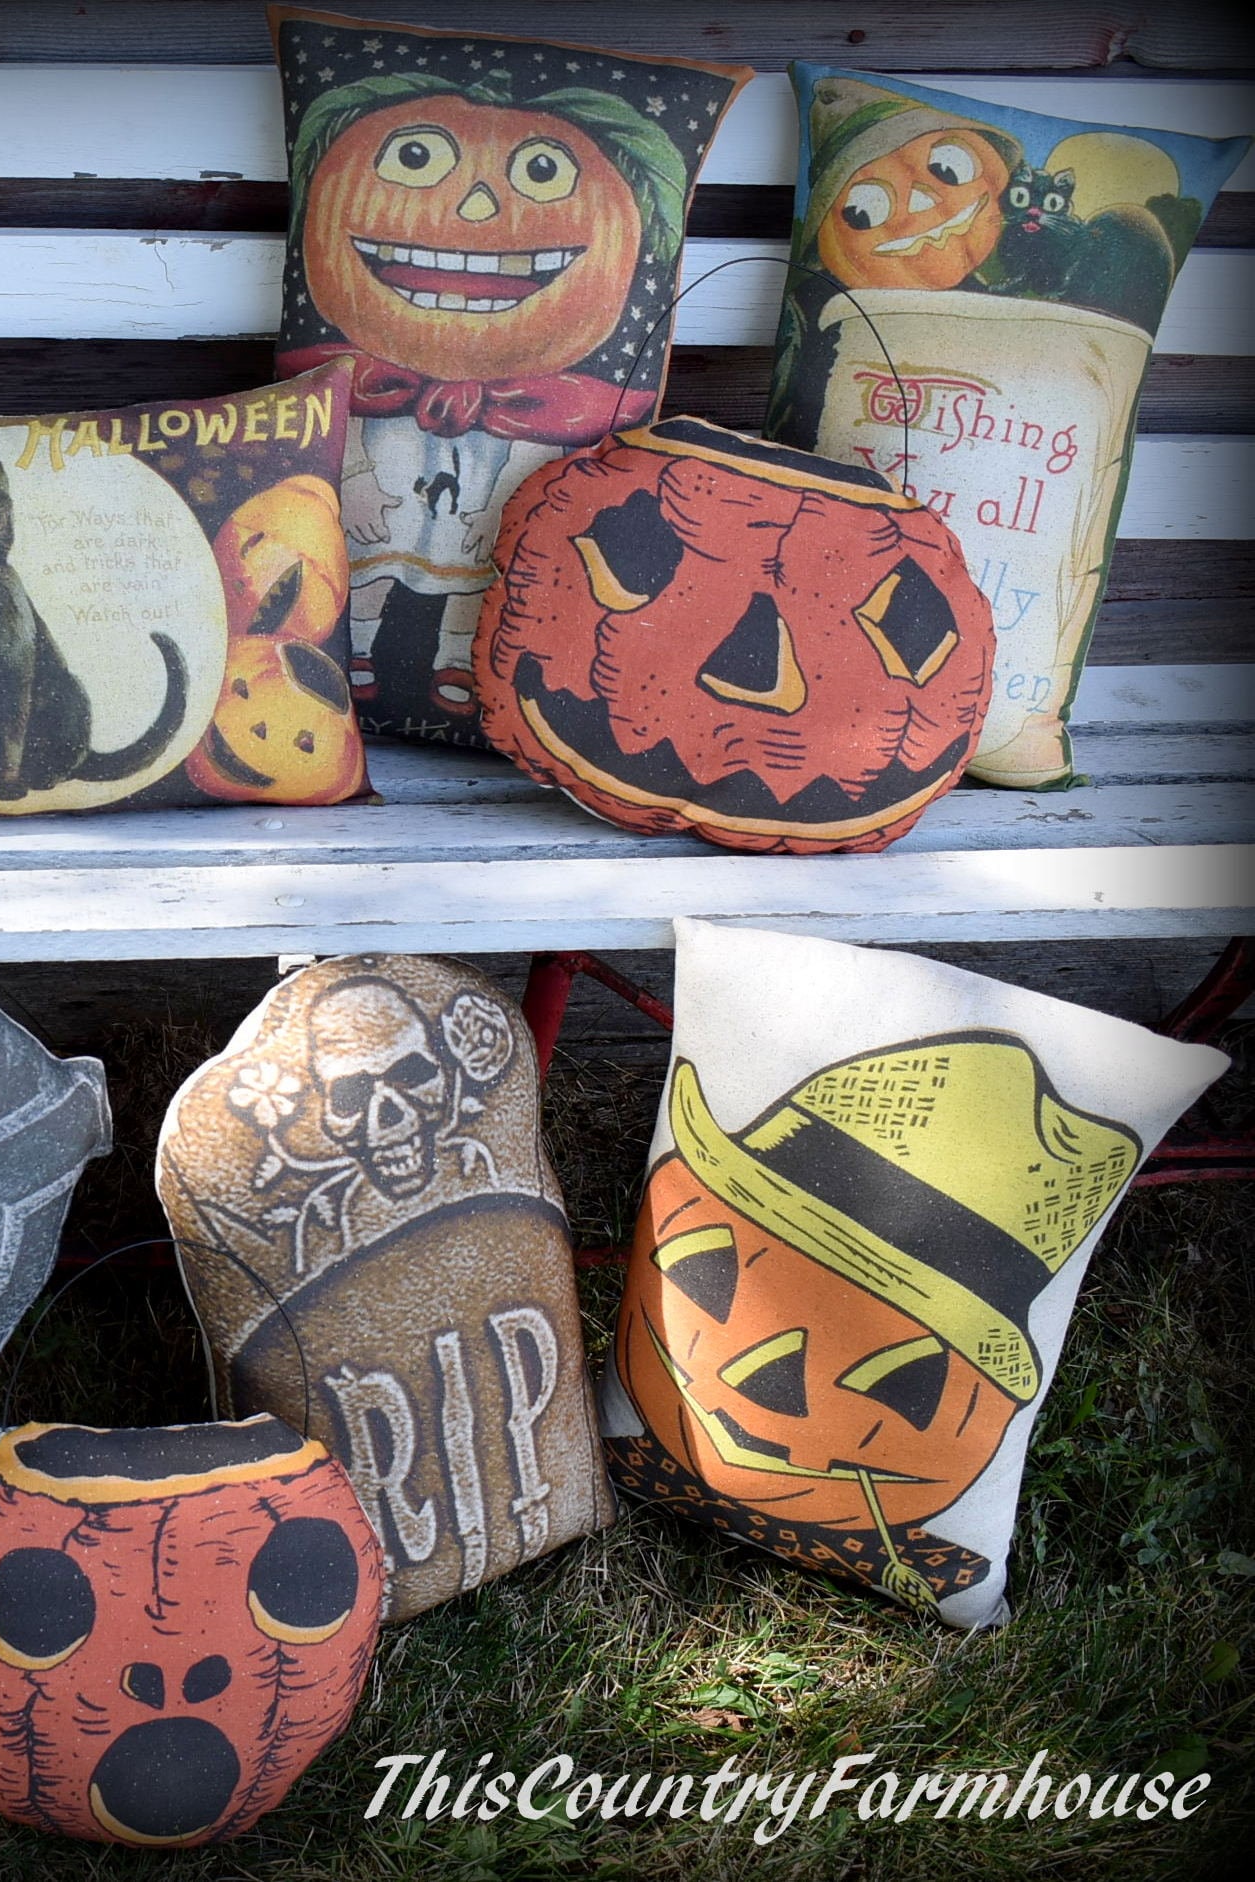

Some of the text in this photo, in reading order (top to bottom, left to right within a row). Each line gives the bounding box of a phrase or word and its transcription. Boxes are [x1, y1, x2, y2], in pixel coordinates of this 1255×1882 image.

[850, 369, 1078, 474] Wishing
[136, 507, 176, 529] that
[977, 476, 1045, 534] all
[73, 537, 105, 550] are
[42, 551, 183, 577] and tricks that
[79, 580, 113, 594] are
[978, 558, 1041, 631] lly
[67, 603, 135, 628] Watch
[396, 716, 492, 751] HALL
[323, 1307, 558, 1621] RIP
